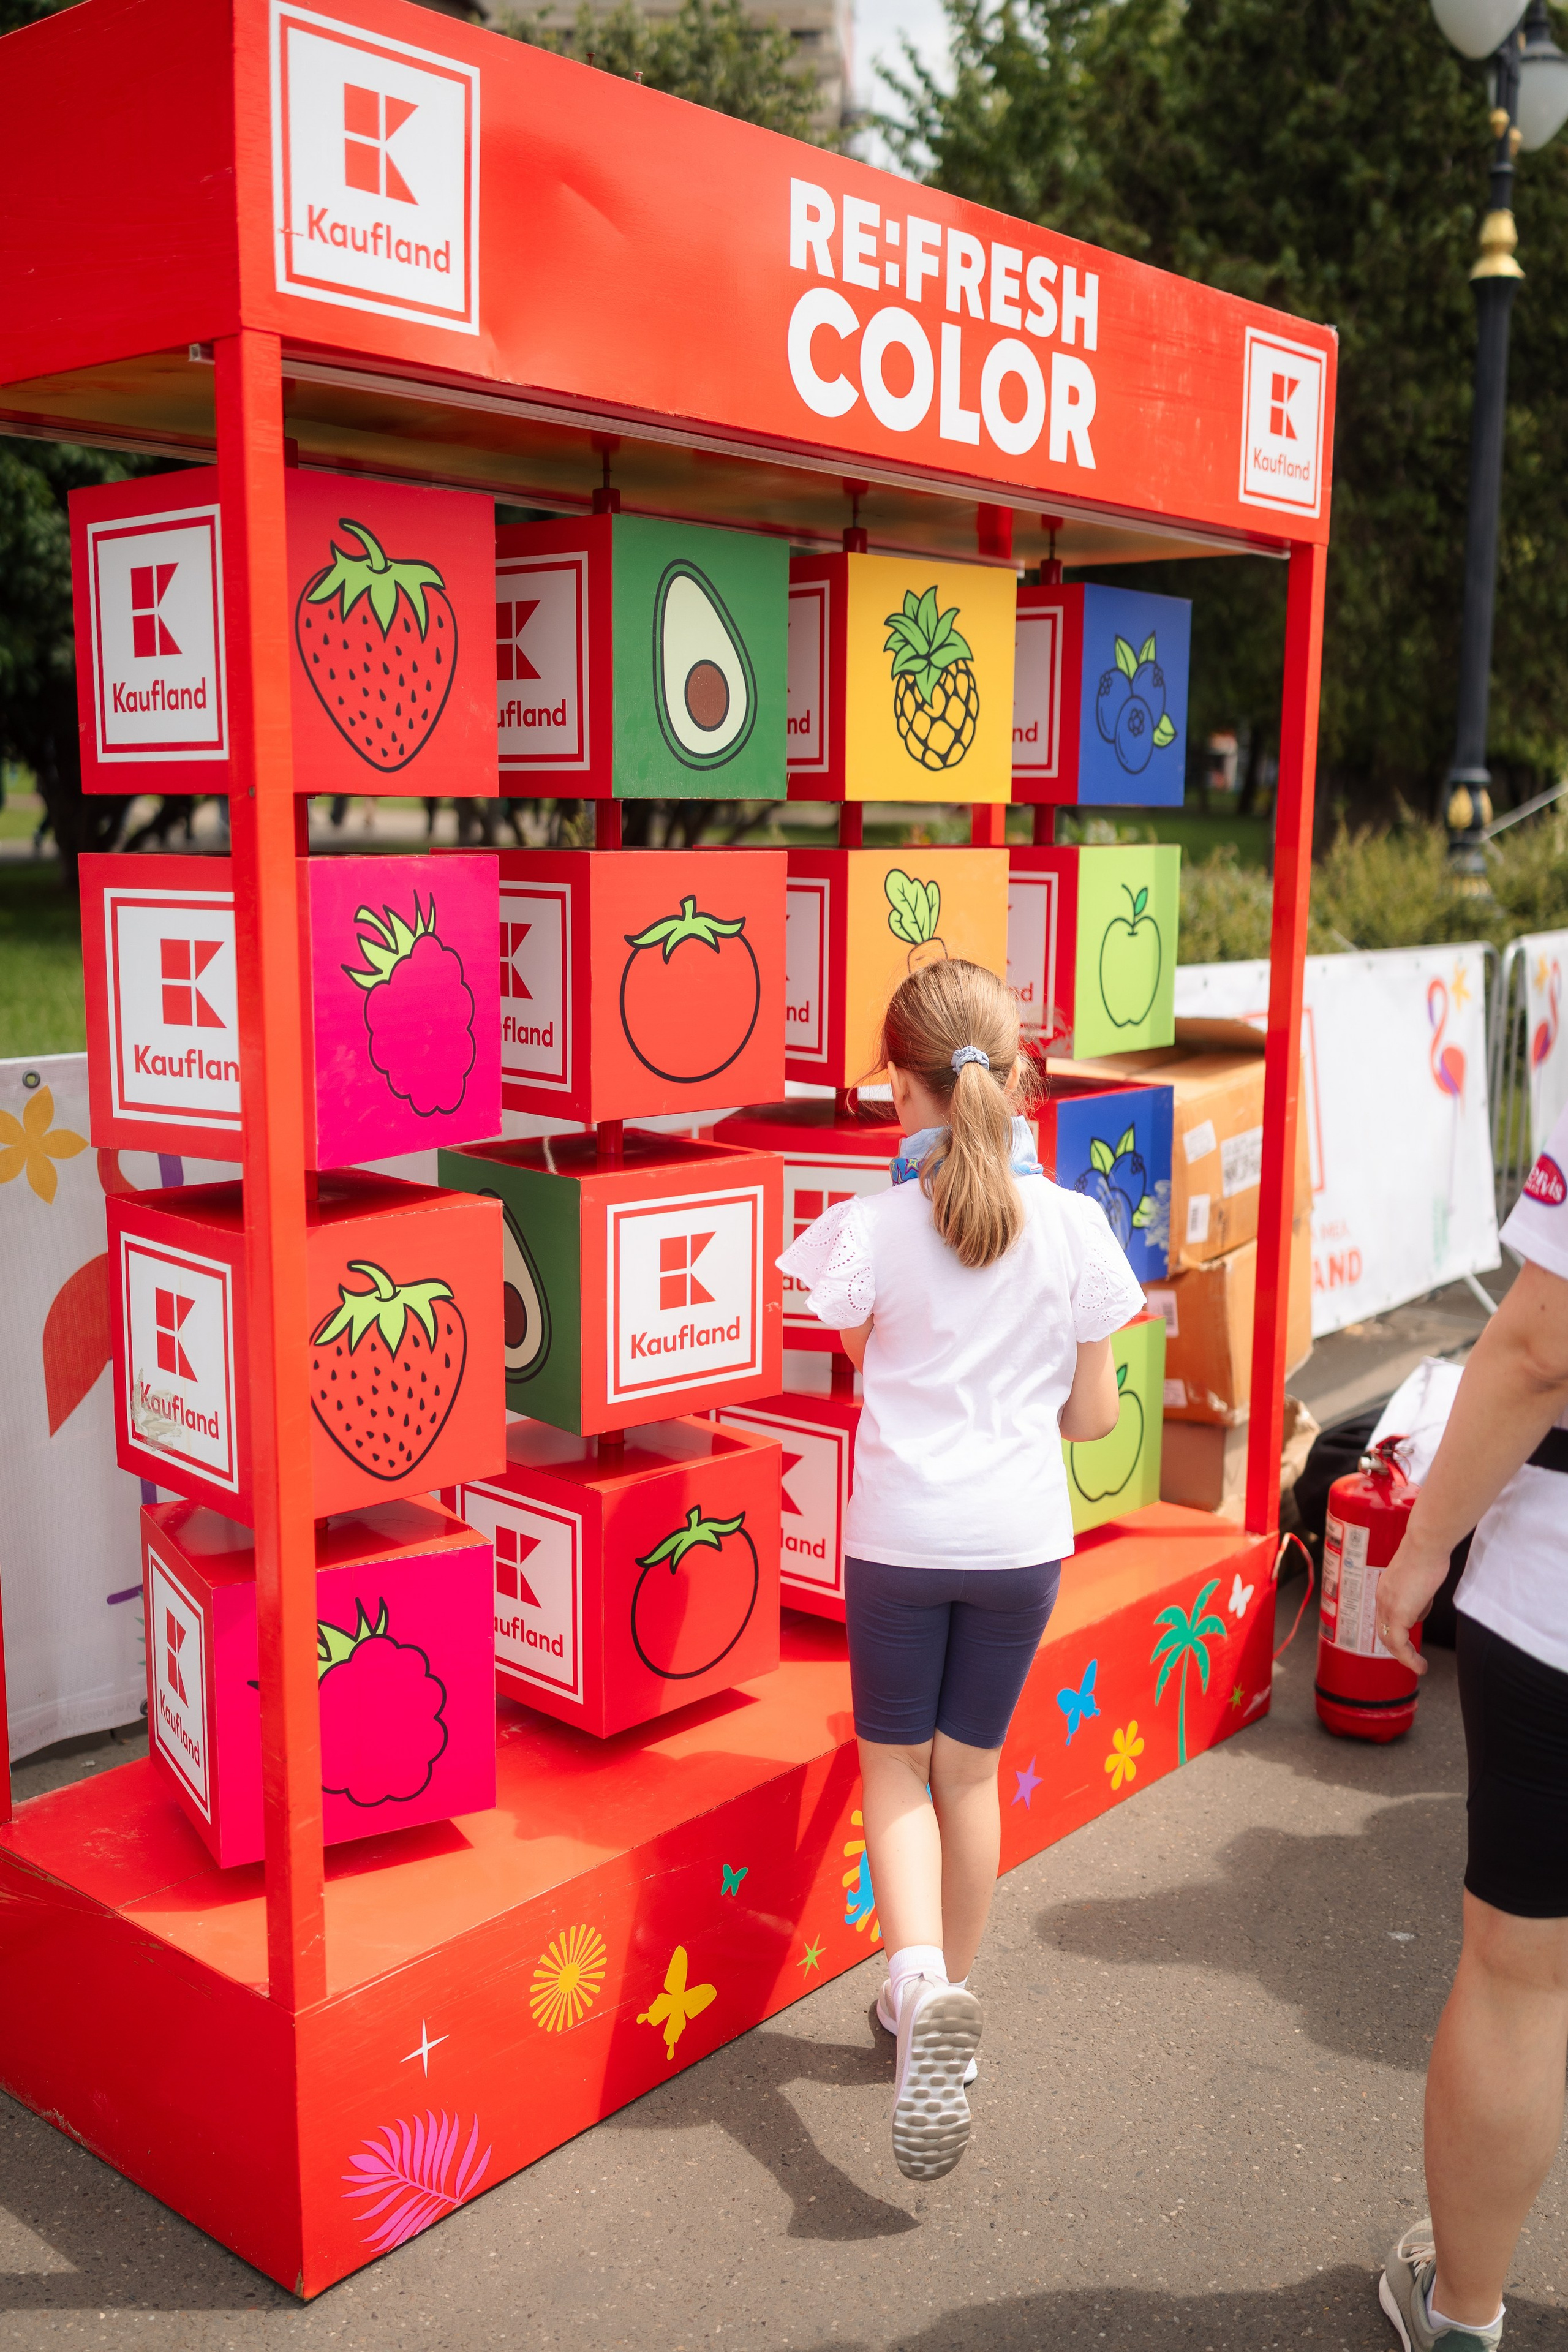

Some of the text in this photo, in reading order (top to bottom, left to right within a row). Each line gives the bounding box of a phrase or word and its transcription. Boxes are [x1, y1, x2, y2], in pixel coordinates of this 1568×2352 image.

[307, 204, 451, 274] Kaufland
[789, 176, 1099, 352] RE:FRESH
[787, 287, 1097, 470] COLOR
[1253, 447, 1310, 481] Kaufland
[113, 677, 207, 713] Kaufland
[497, 698, 567, 728] ufland
[502, 1016, 554, 1048] fland
[134, 1044, 241, 1082] Kauflan
[1311, 1248, 1362, 1292] AND
[631, 1316, 741, 1359] Kaufland
[140, 1380, 219, 1440] Kaufland
[780, 1527, 825, 1559] land
[159, 1688, 200, 1768] Kaufland
